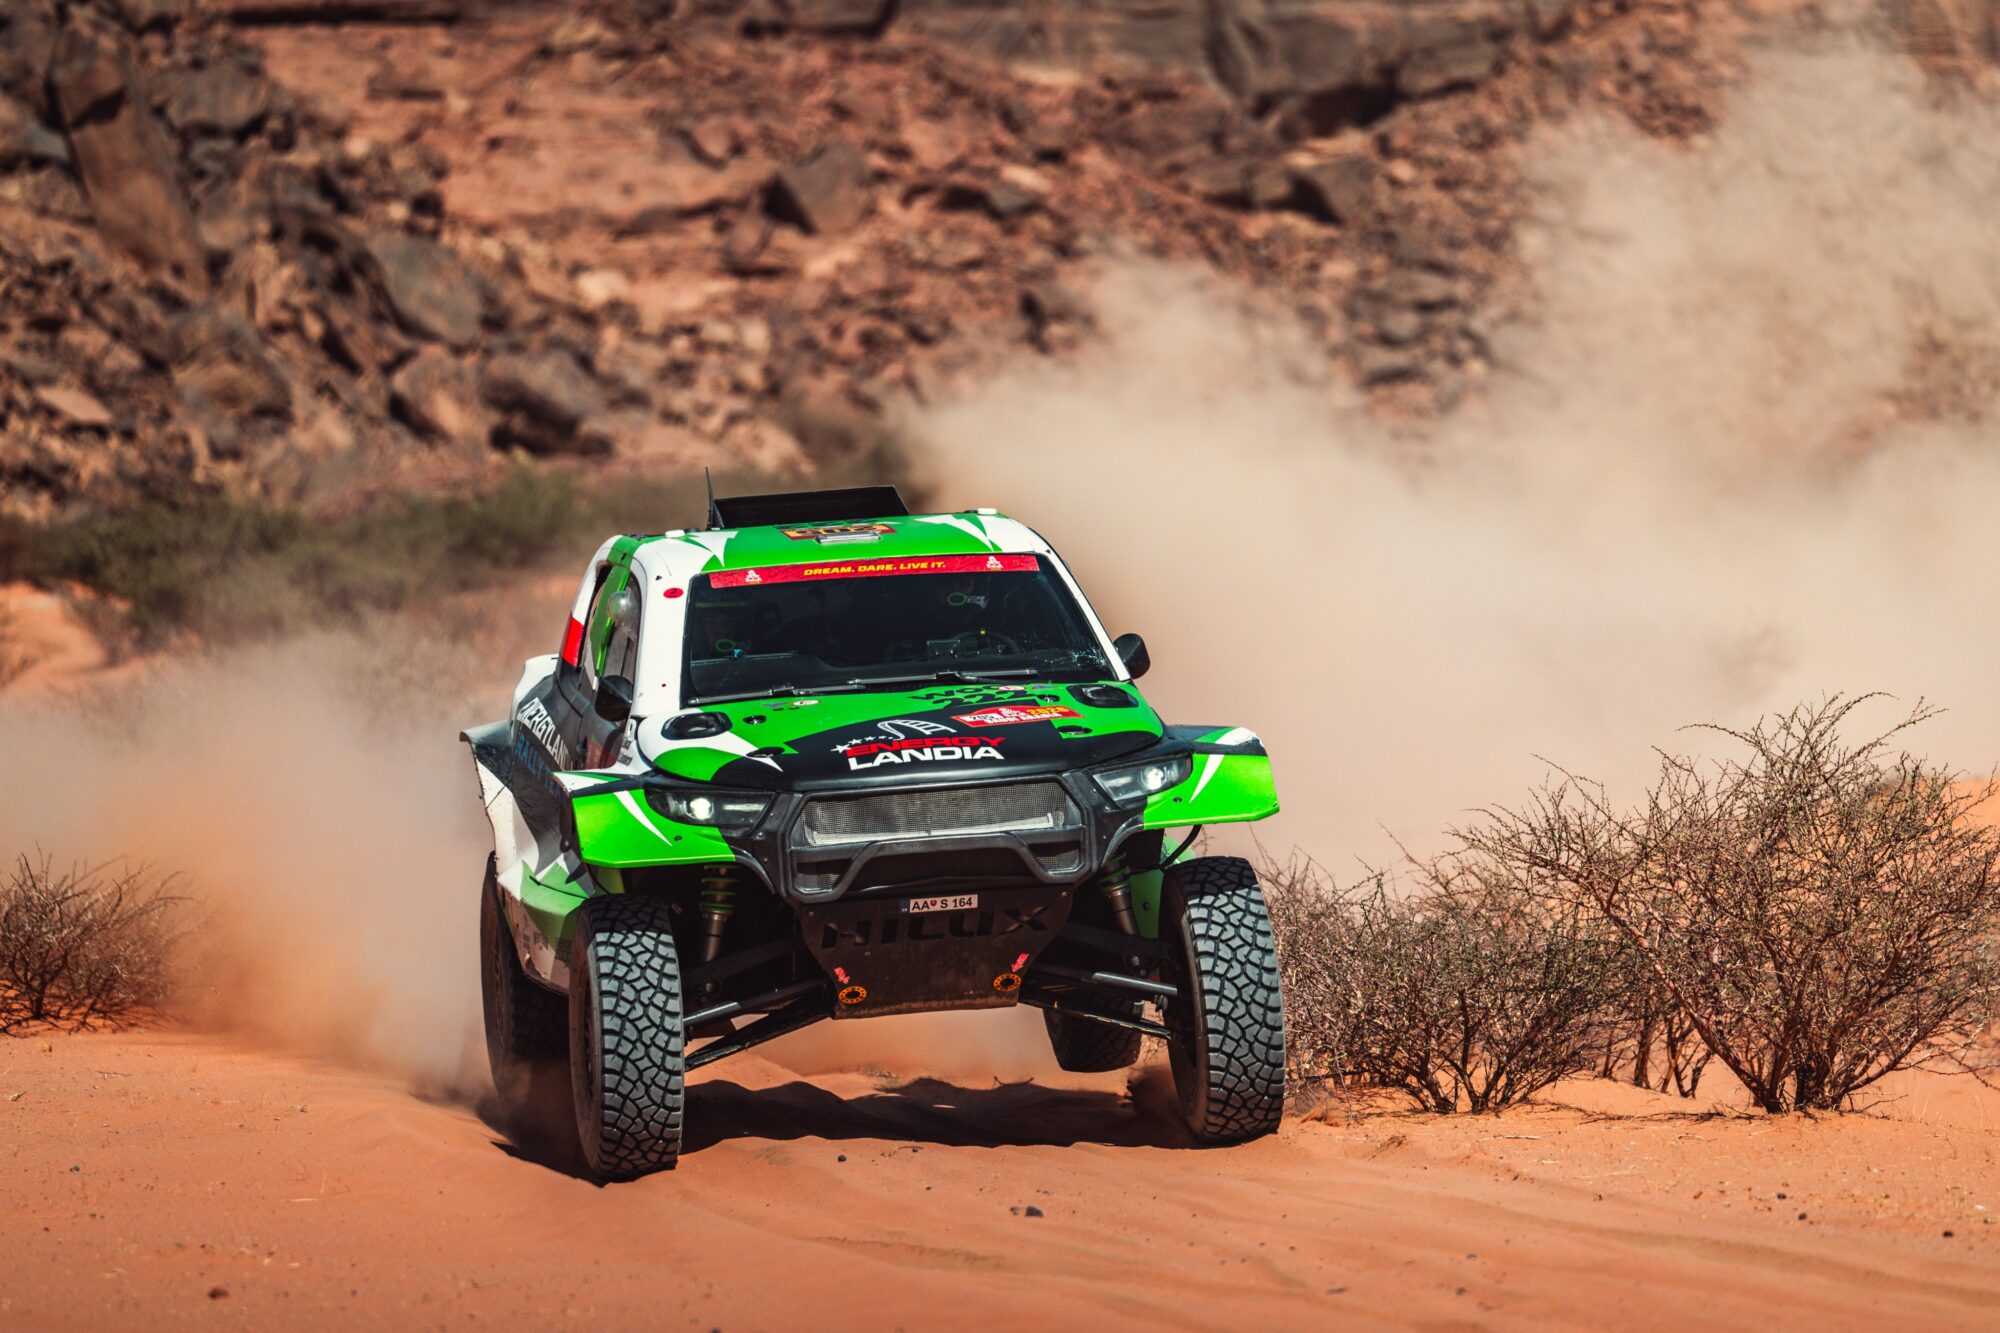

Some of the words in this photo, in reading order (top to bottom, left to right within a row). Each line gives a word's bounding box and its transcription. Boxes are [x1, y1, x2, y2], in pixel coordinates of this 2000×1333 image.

[804, 566, 855, 576] DREAM.
[858, 563, 897, 572] DARE.
[900, 562, 928, 570] LIVE
[931, 561, 946, 569] IT.
[845, 736, 1007, 758] ENERGY
[848, 746, 1005, 771] LANDIA
[912, 900, 930, 911] AA
[940, 898, 949, 909] S
[952, 897, 973, 908] 164
[821, 905, 1048, 949] HILUX
